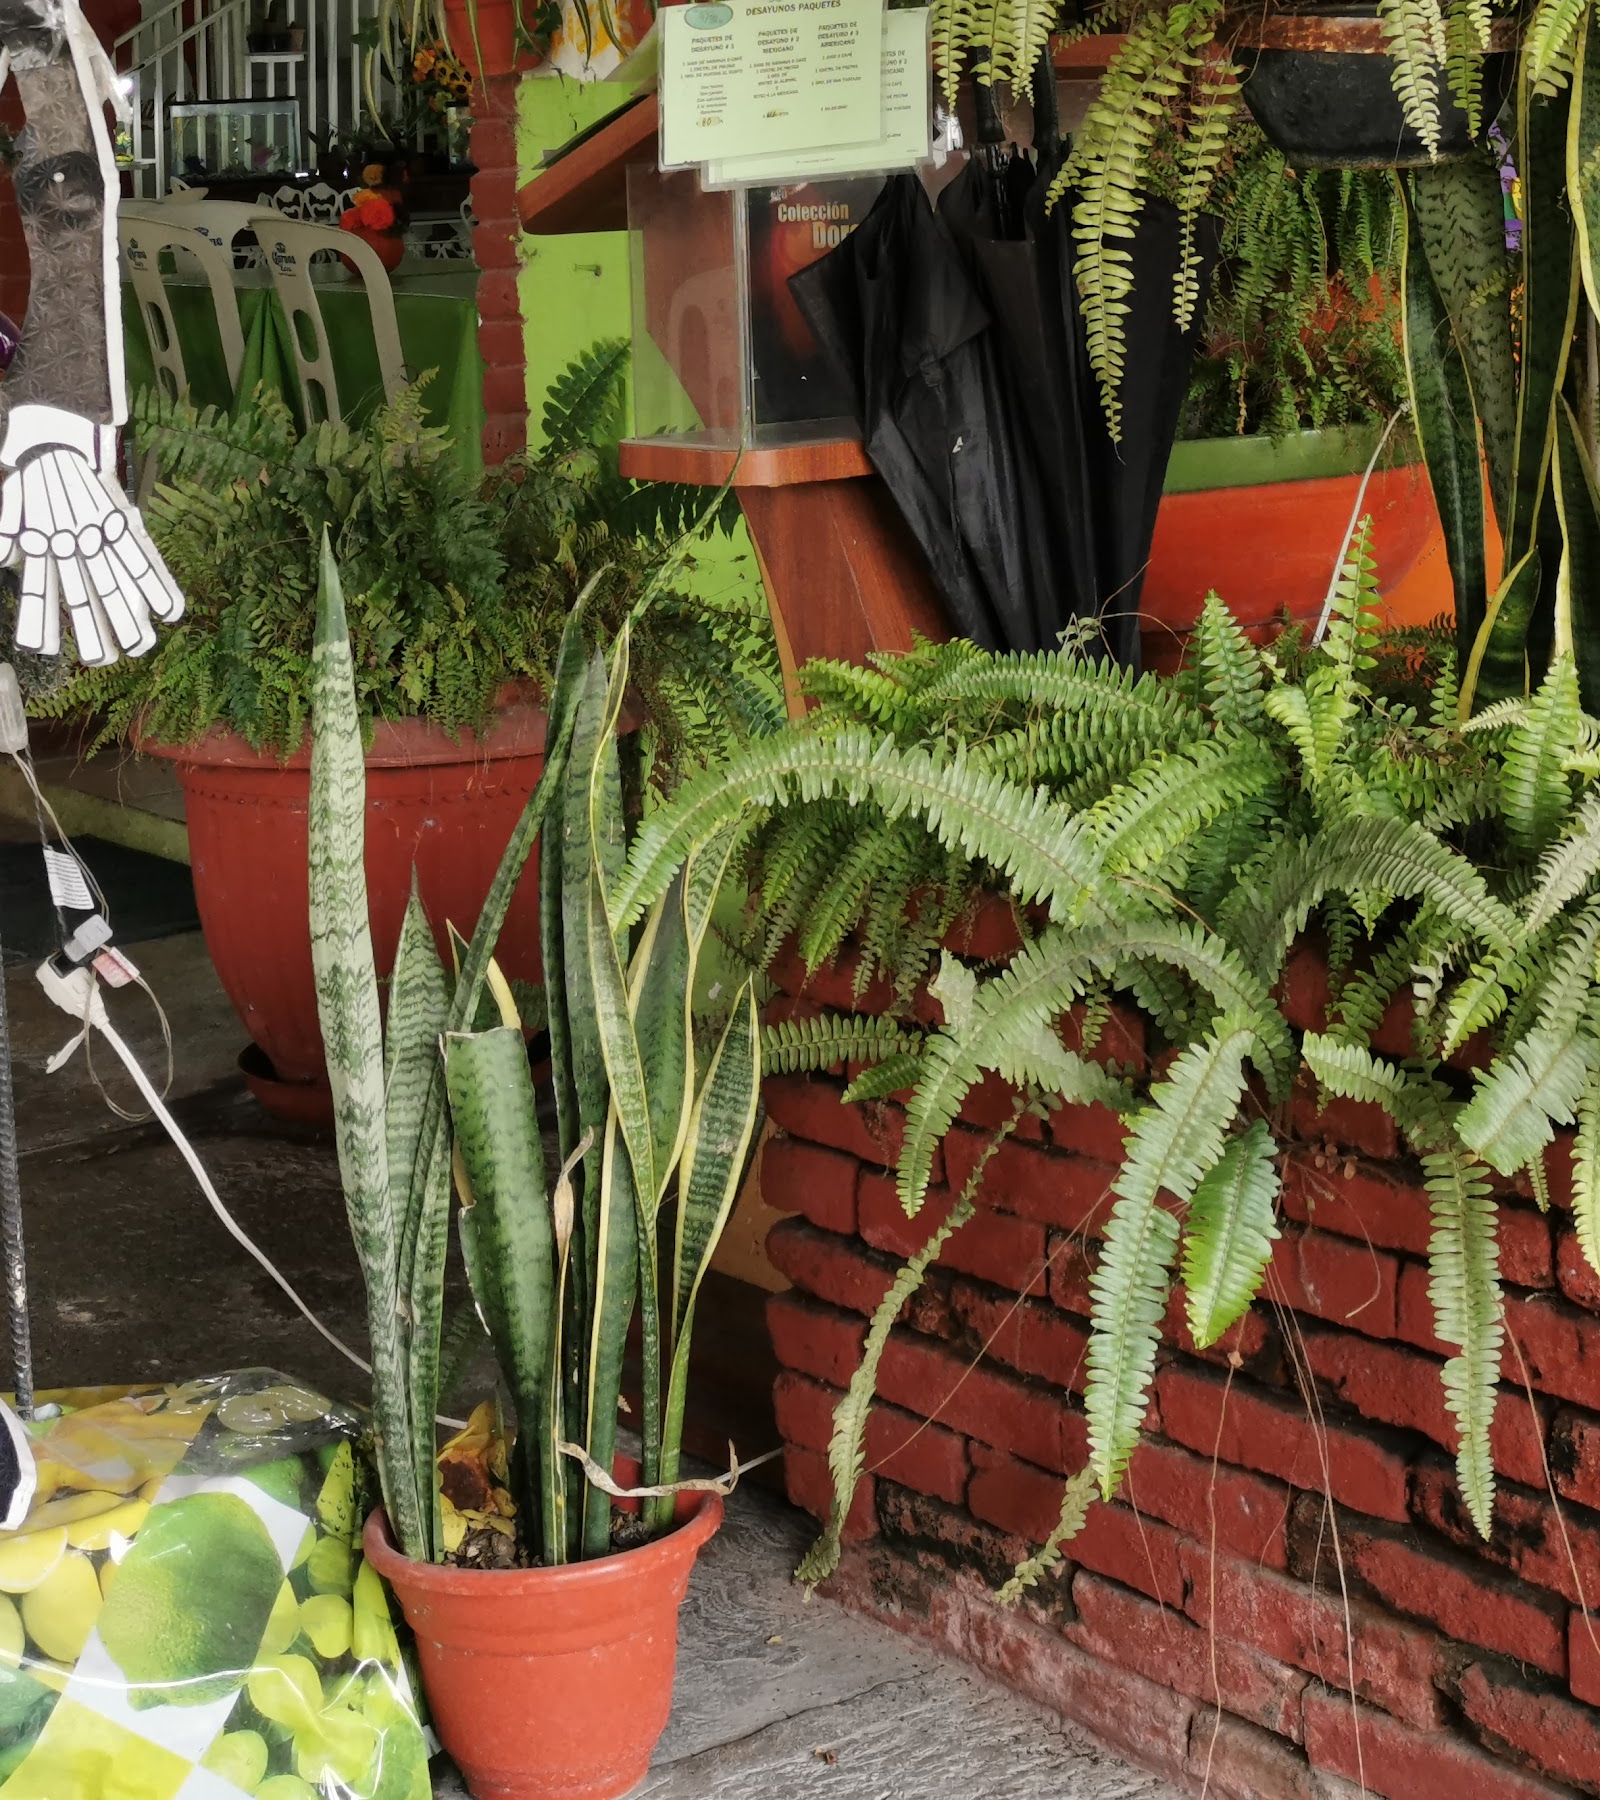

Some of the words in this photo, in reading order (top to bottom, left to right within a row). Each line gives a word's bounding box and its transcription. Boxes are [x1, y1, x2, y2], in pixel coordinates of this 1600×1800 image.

[745, 3, 796, 16] DESAYUNOS
[798, 0, 841, 12] PAQUETES
[777, 201, 850, 223] Colección
